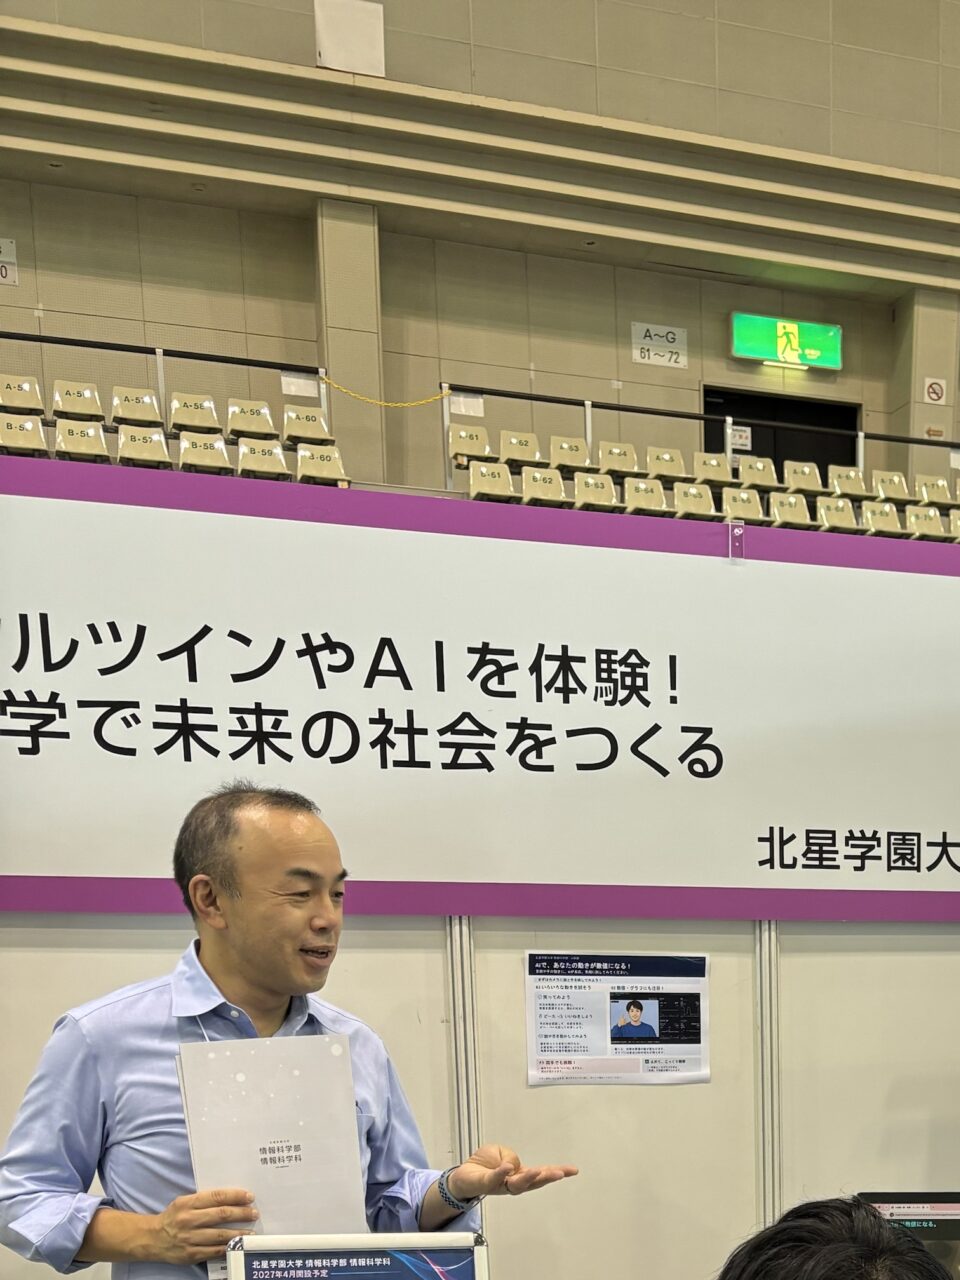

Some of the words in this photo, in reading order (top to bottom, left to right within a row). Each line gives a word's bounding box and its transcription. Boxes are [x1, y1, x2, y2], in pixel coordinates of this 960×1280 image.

[5, 383, 30, 391] A-5
[65, 389, 91, 398] A-5
[6, 422, 32, 431] B-5
[67, 428, 94, 438] B-5
[11, 611, 682, 706] ルツインやAIを体験！
[0, 688, 725, 780] 学で未来の社会をつくる
[252, 1259, 303, 1269] 北星学園大学
[305, 1258, 347, 1268] 情報科学部
[349, 1257, 391, 1267] 情報科学科
[252, 1269, 329, 1279] 2027年4月開設予定
